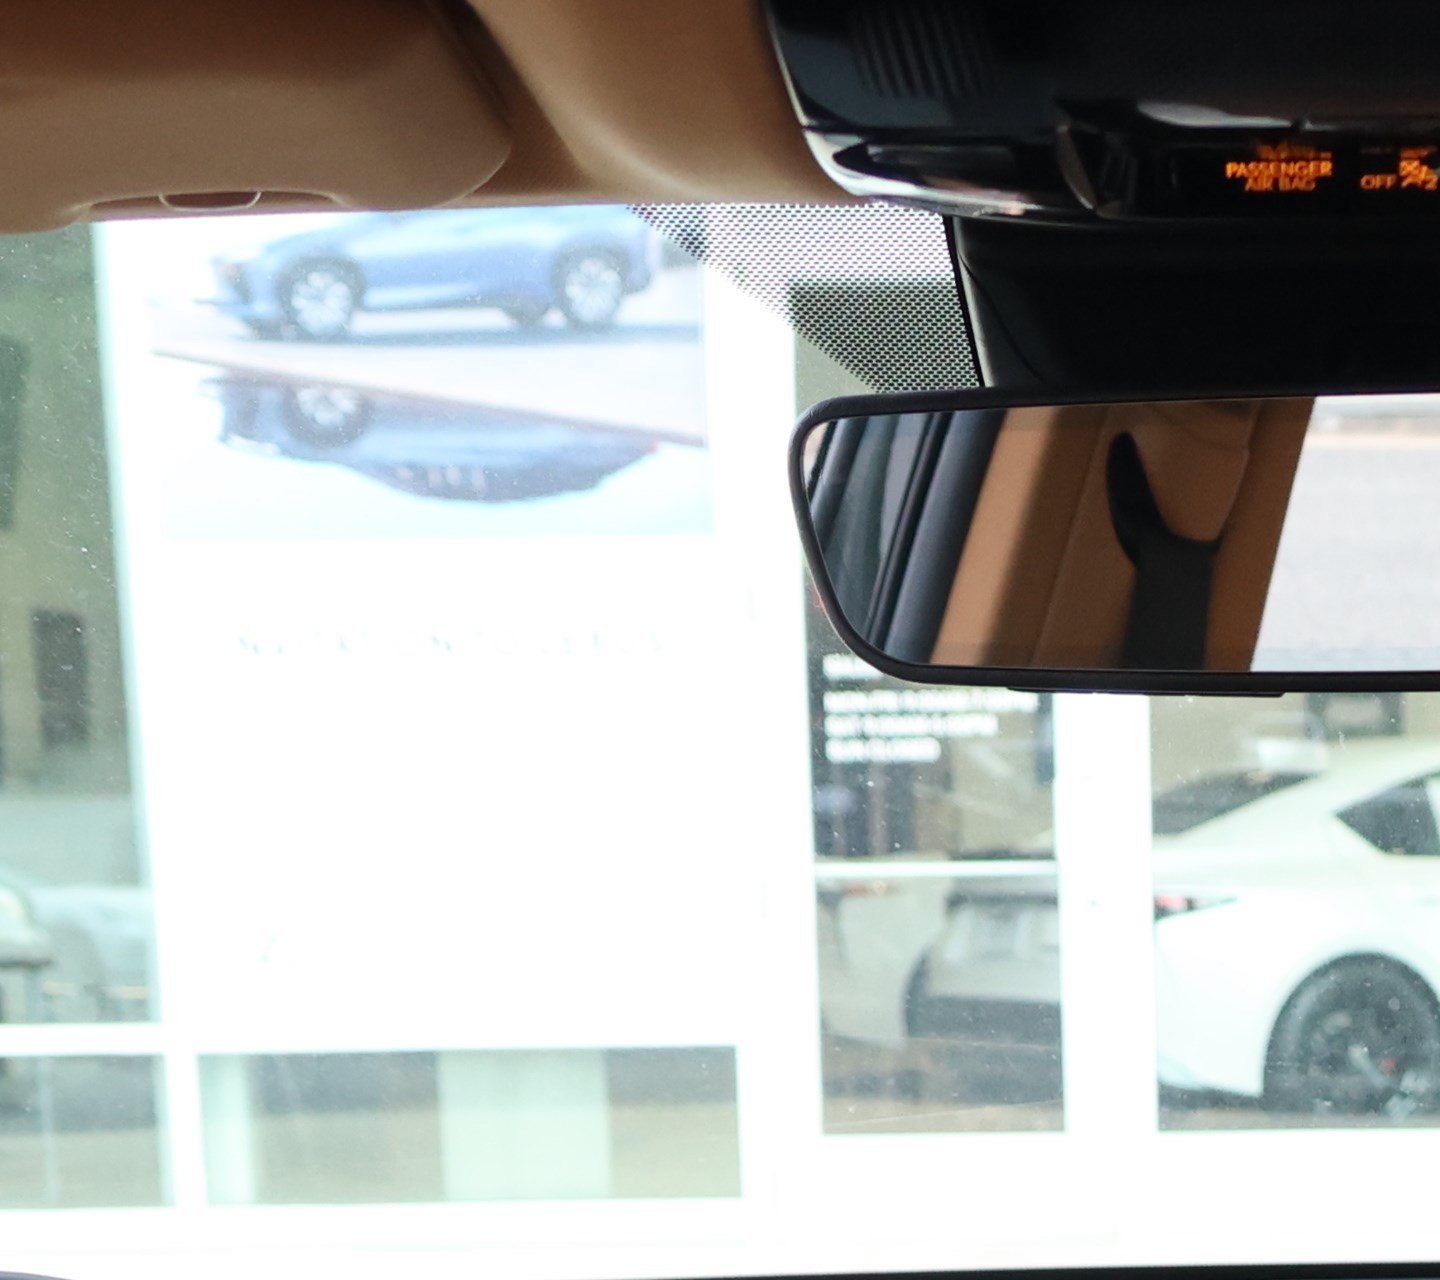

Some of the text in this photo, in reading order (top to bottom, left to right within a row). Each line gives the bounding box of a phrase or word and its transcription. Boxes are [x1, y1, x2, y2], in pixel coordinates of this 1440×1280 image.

[1225, 161, 1333, 178] PASSENGER
[1245, 175, 1317, 192] AIR BAG
[1360, 174, 1396, 190] OFF
